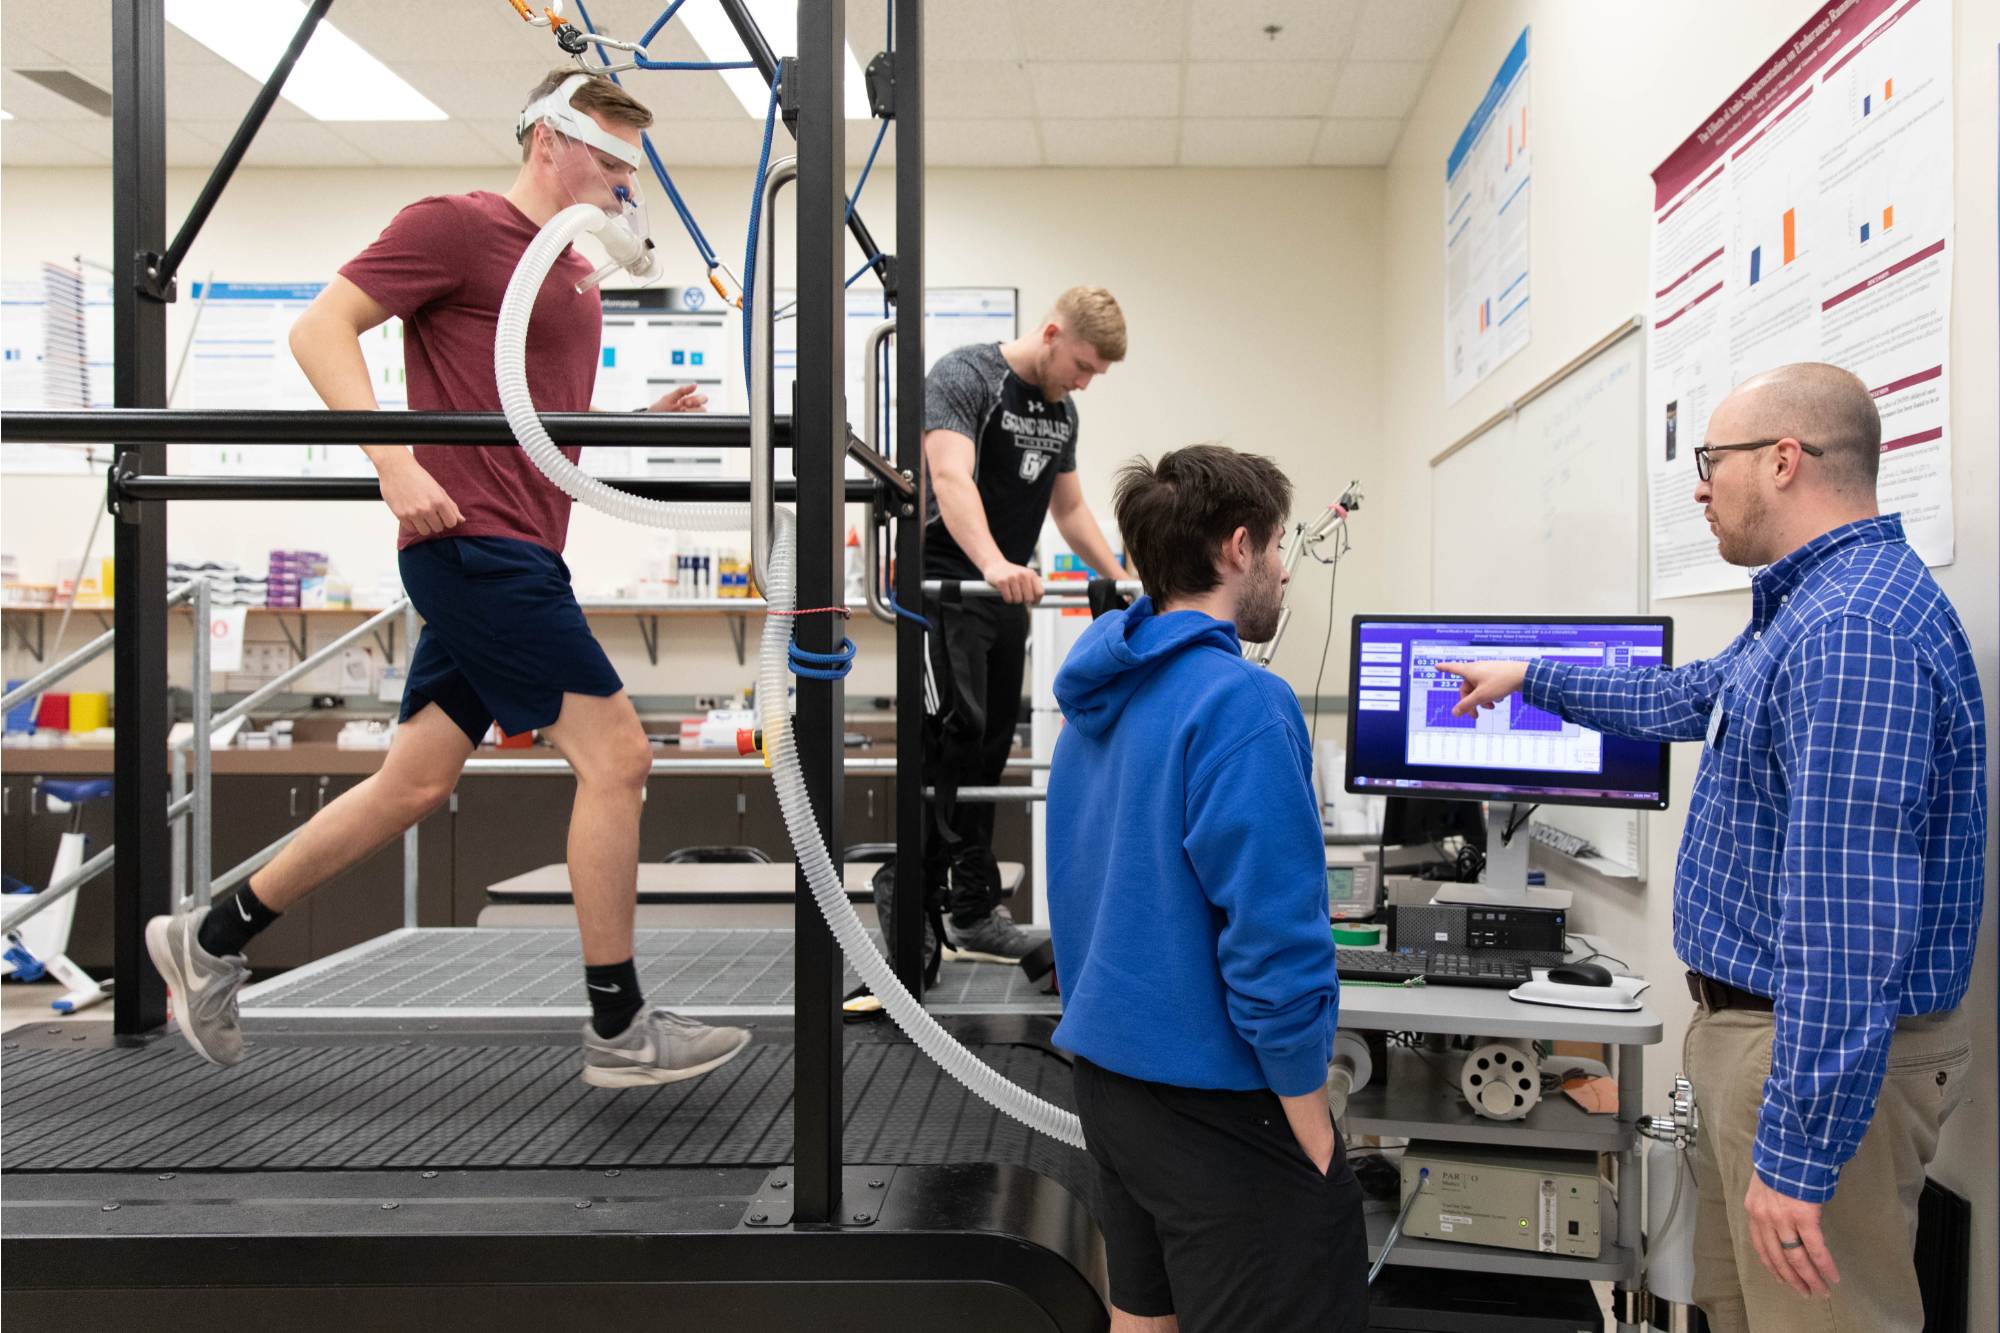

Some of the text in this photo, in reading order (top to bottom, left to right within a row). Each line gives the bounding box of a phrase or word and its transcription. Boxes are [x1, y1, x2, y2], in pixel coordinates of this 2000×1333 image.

[1793, 19, 1831, 54] Endurance
[1828, 0, 1860, 23] Runnin
[1001, 410, 1072, 443] GRAND VALLE
